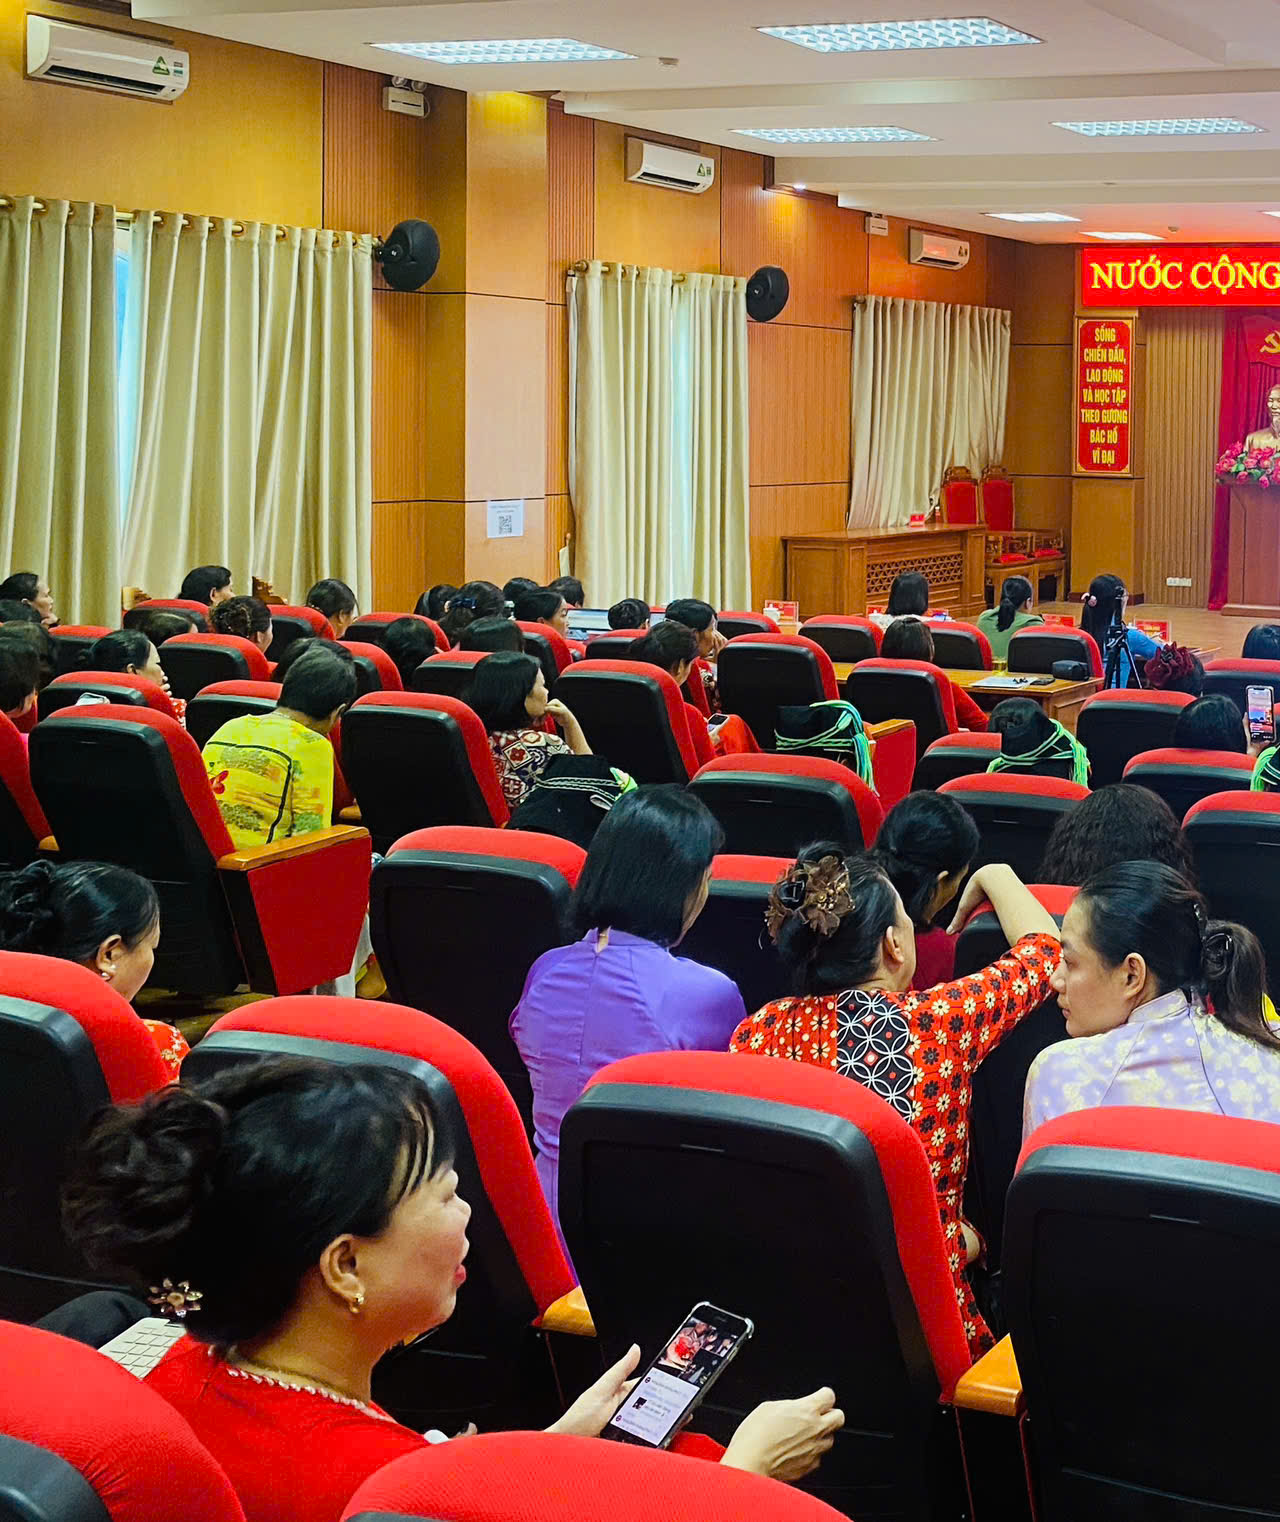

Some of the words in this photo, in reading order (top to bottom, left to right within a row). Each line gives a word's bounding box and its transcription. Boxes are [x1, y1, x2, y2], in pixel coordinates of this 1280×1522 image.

[1092, 255, 1181, 289] NƯỚC
[1095, 325, 1116, 342] SỐNG
[1084, 345, 1106, 363] CHIẾN
[1108, 345, 1127, 365] ĐẤU,
[1086, 369, 1101, 382] LAO
[1102, 366, 1124, 386] ĐỘNG
[1083, 385, 1093, 403] VÀ
[1094, 389, 1110, 405] HỌC
[1112, 385, 1126, 406] TẬP
[1081, 409, 1100, 423] THEO
[1102, 408, 1127, 424] GƯƠNG
[1090, 428, 1106, 443] BÁC
[1092, 448, 1100, 463] VĨ
[1101, 450, 1114, 466] ĐẠI
